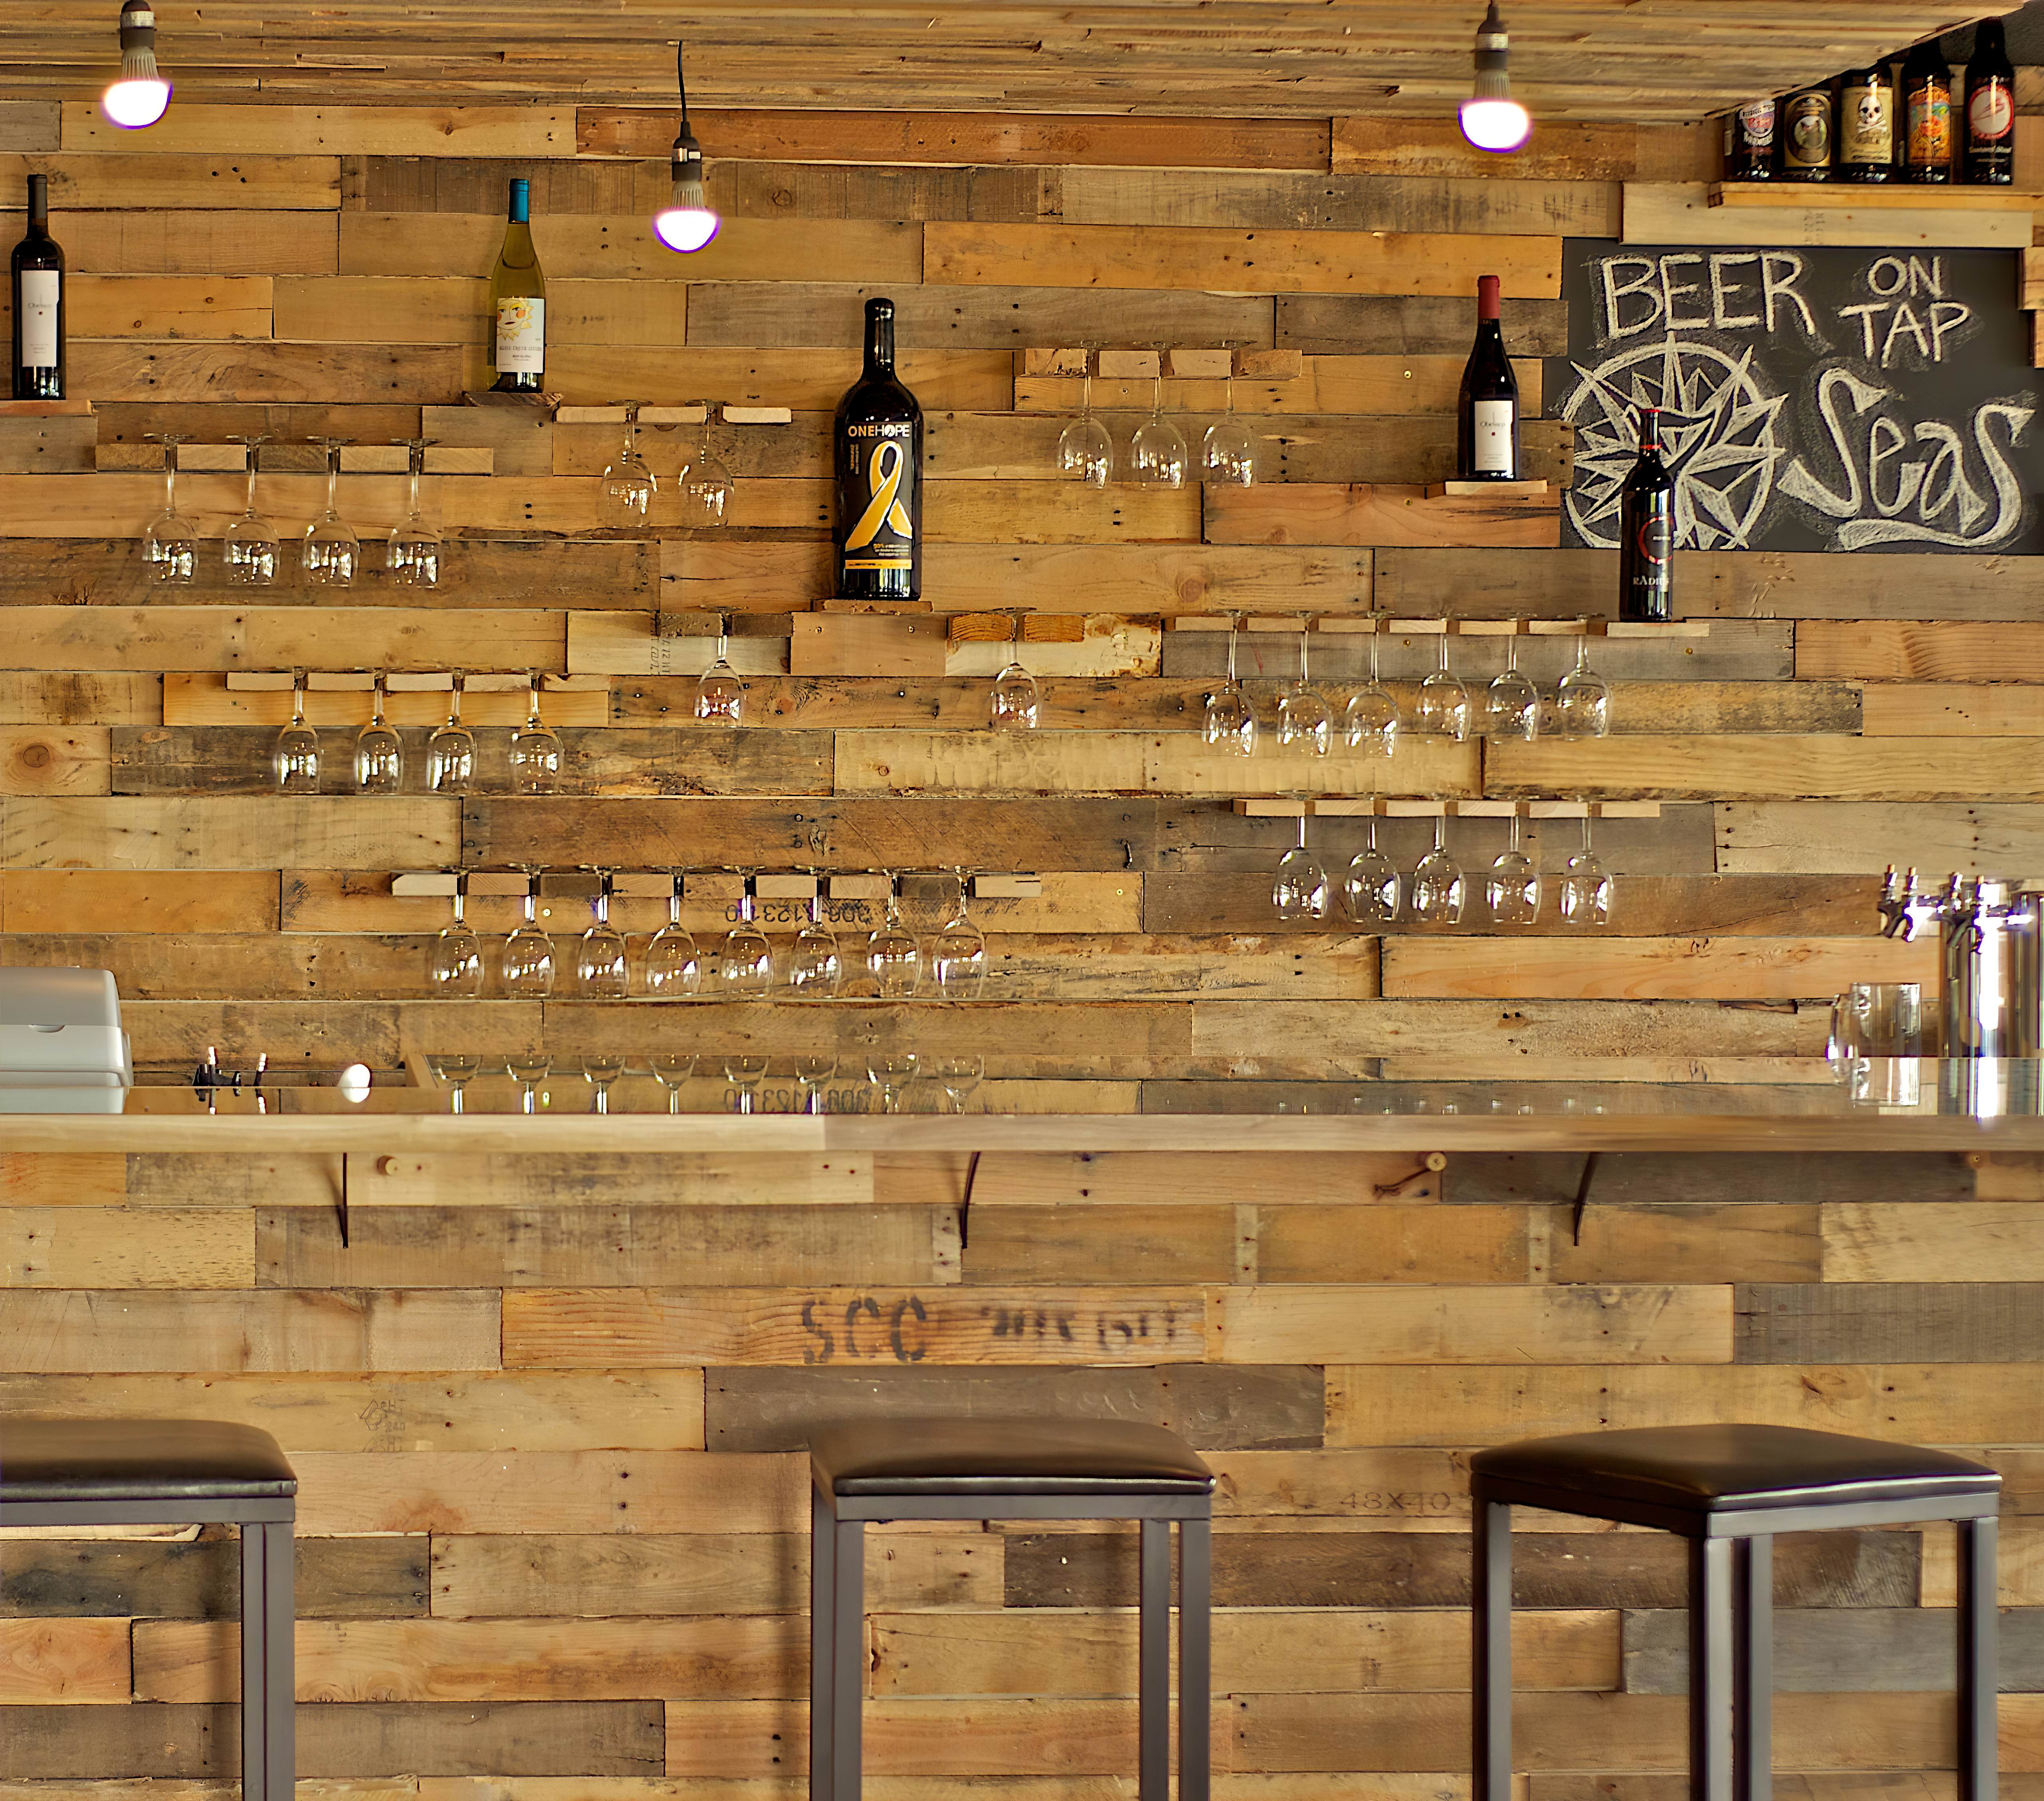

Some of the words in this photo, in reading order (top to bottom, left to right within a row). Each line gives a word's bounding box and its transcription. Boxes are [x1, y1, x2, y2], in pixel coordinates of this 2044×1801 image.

[1601, 251, 1817, 339] BEER
[1868, 254, 1943, 298] ON
[1838, 300, 1971, 368] TAP
[848, 424, 910, 437] ONEHOPE
